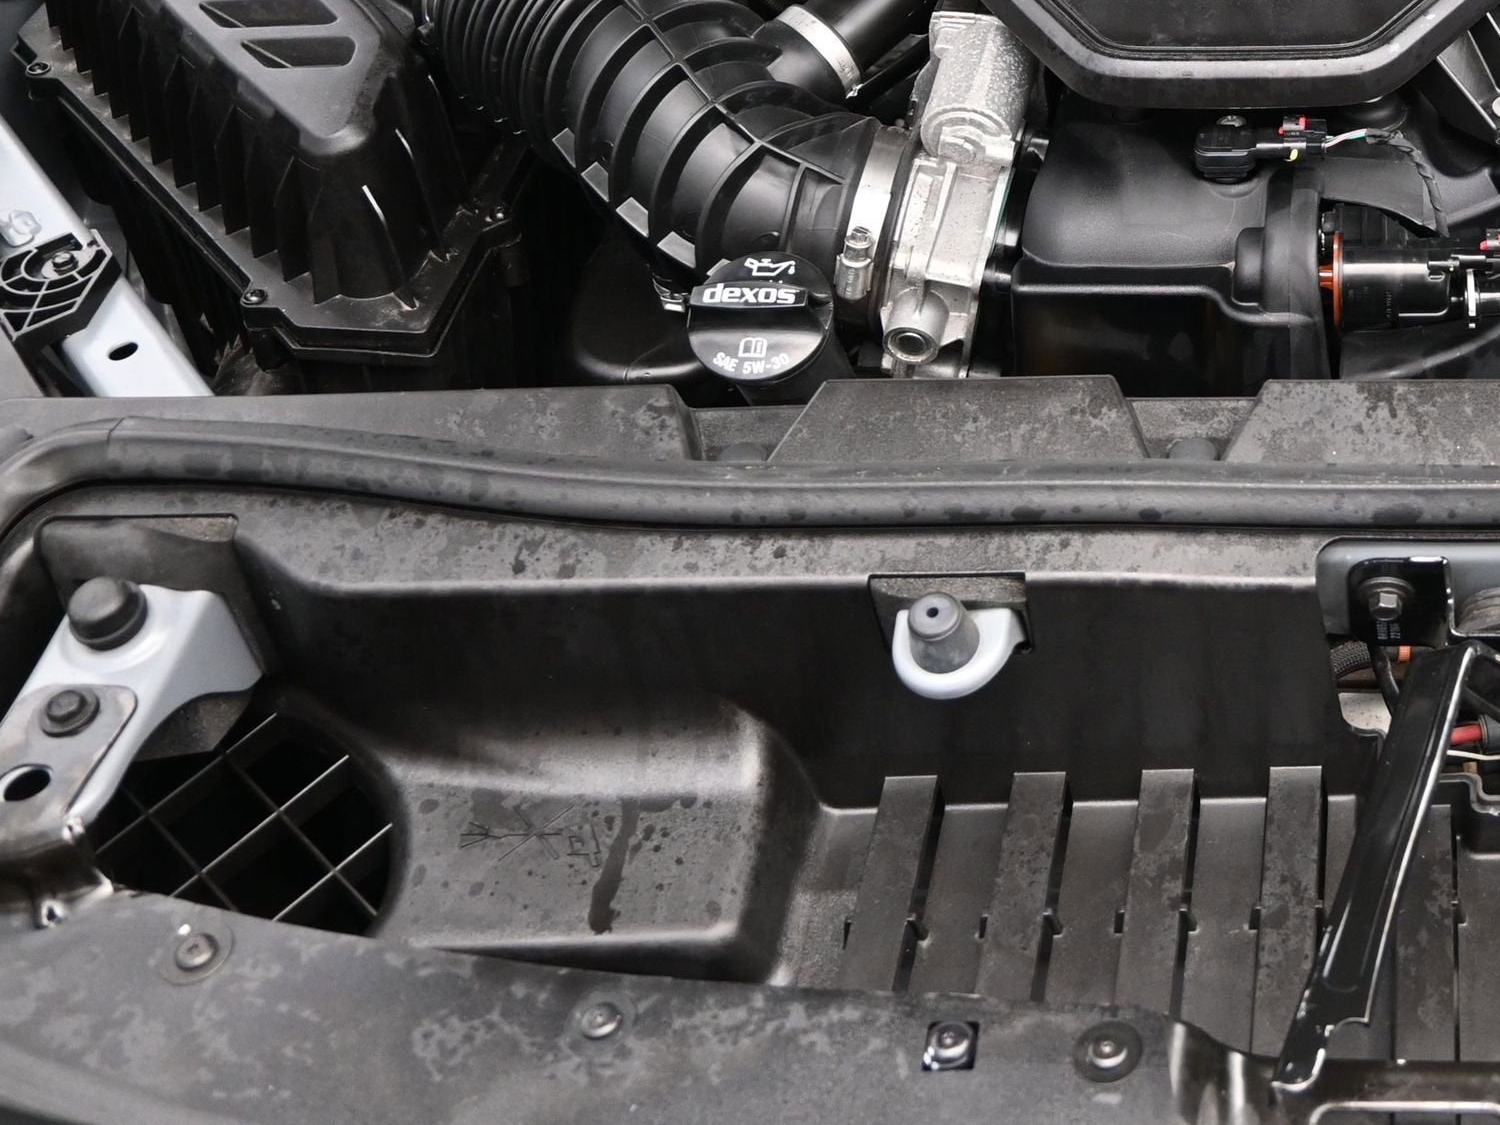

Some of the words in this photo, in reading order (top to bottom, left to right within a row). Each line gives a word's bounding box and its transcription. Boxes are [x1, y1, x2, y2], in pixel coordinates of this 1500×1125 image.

[702, 282, 797, 304] dexos
[713, 352, 739, 372] SAE
[742, 353, 790, 374] 5W-30
